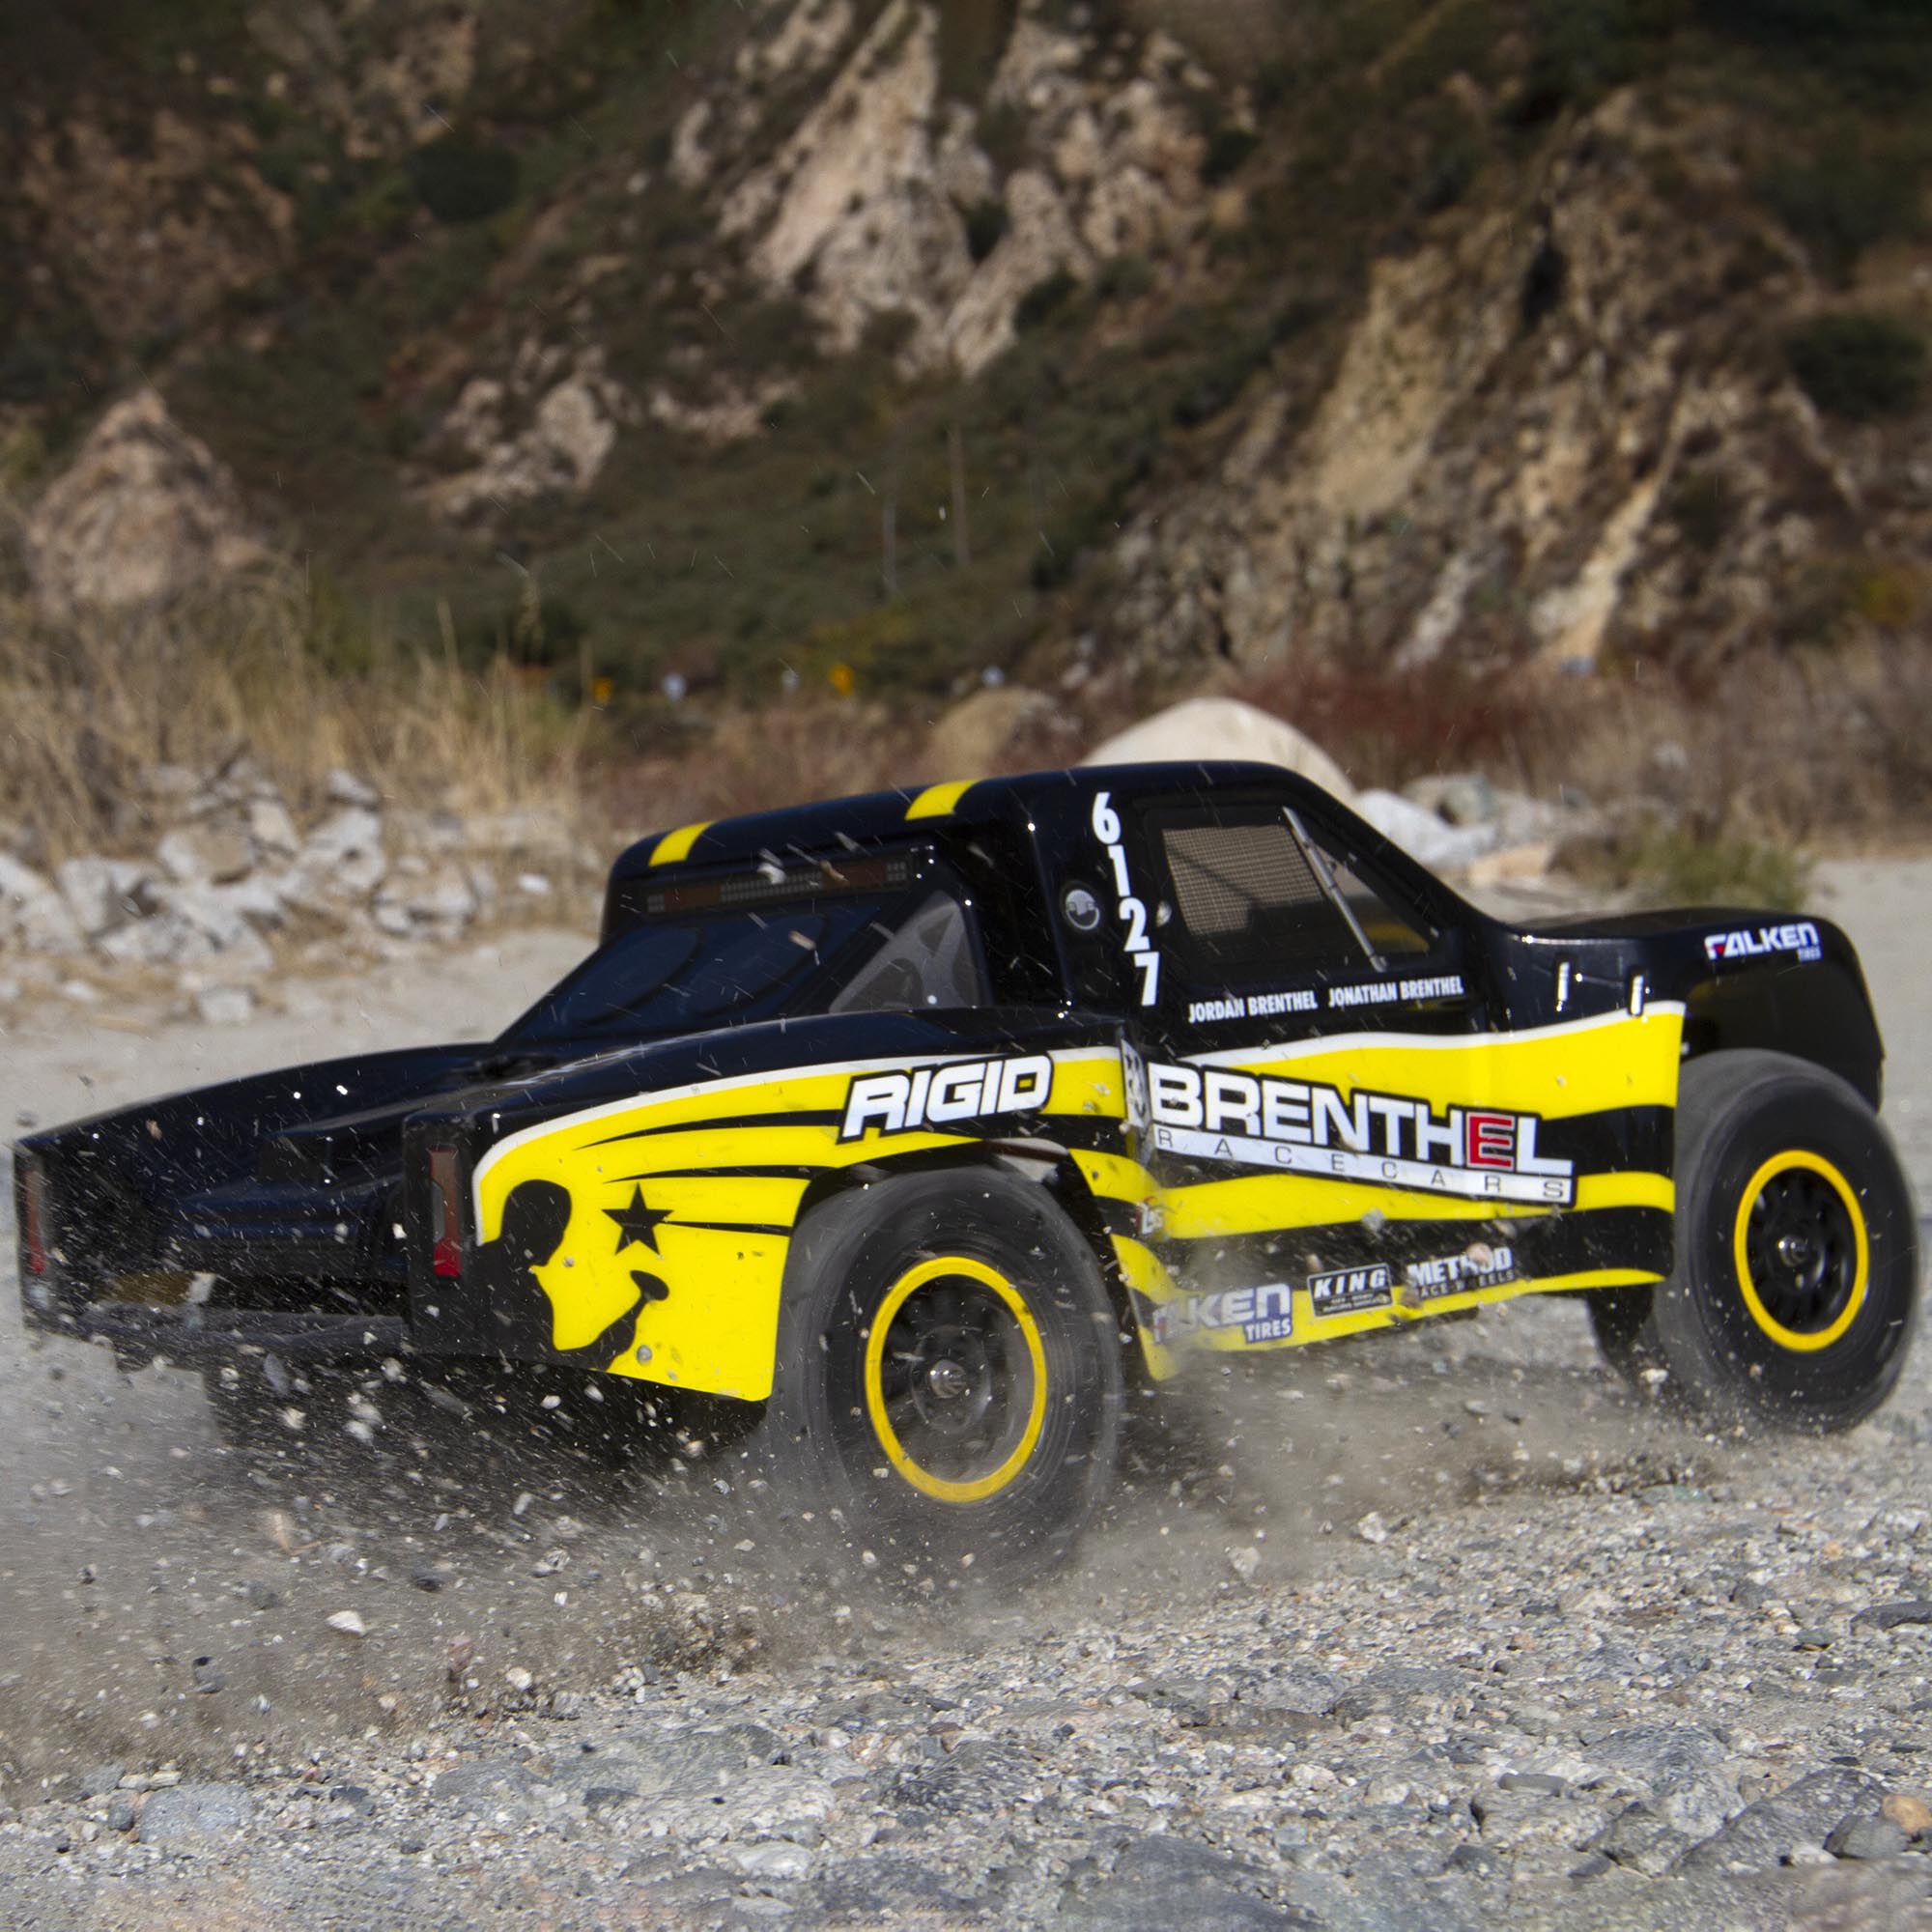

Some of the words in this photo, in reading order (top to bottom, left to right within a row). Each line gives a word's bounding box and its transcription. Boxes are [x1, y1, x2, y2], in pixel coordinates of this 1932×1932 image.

[1092, 791, 1160, 1007] 6127
[1704, 922, 1819, 960] FALKEN
[1187, 998, 1245, 1023] JORDAN
[1247, 990, 1318, 1016] BRENTHEL
[1328, 981, 1398, 1007] JONATHAN
[1400, 976, 1464, 1001] BRENTHEL
[842, 1055, 1052, 1139] RIGID
[1148, 1063, 1573, 1176] BRENTHEL
[1158, 1128, 1564, 1199] RACECARS
[1314, 1268, 1387, 1299] KING
[1412, 1283, 1448, 1301] ACE
[1455, 1269, 1516, 1293] WEELS
[1152, 1283, 1291, 1343] FKEN
[1244, 1319, 1291, 1342] TIRES
